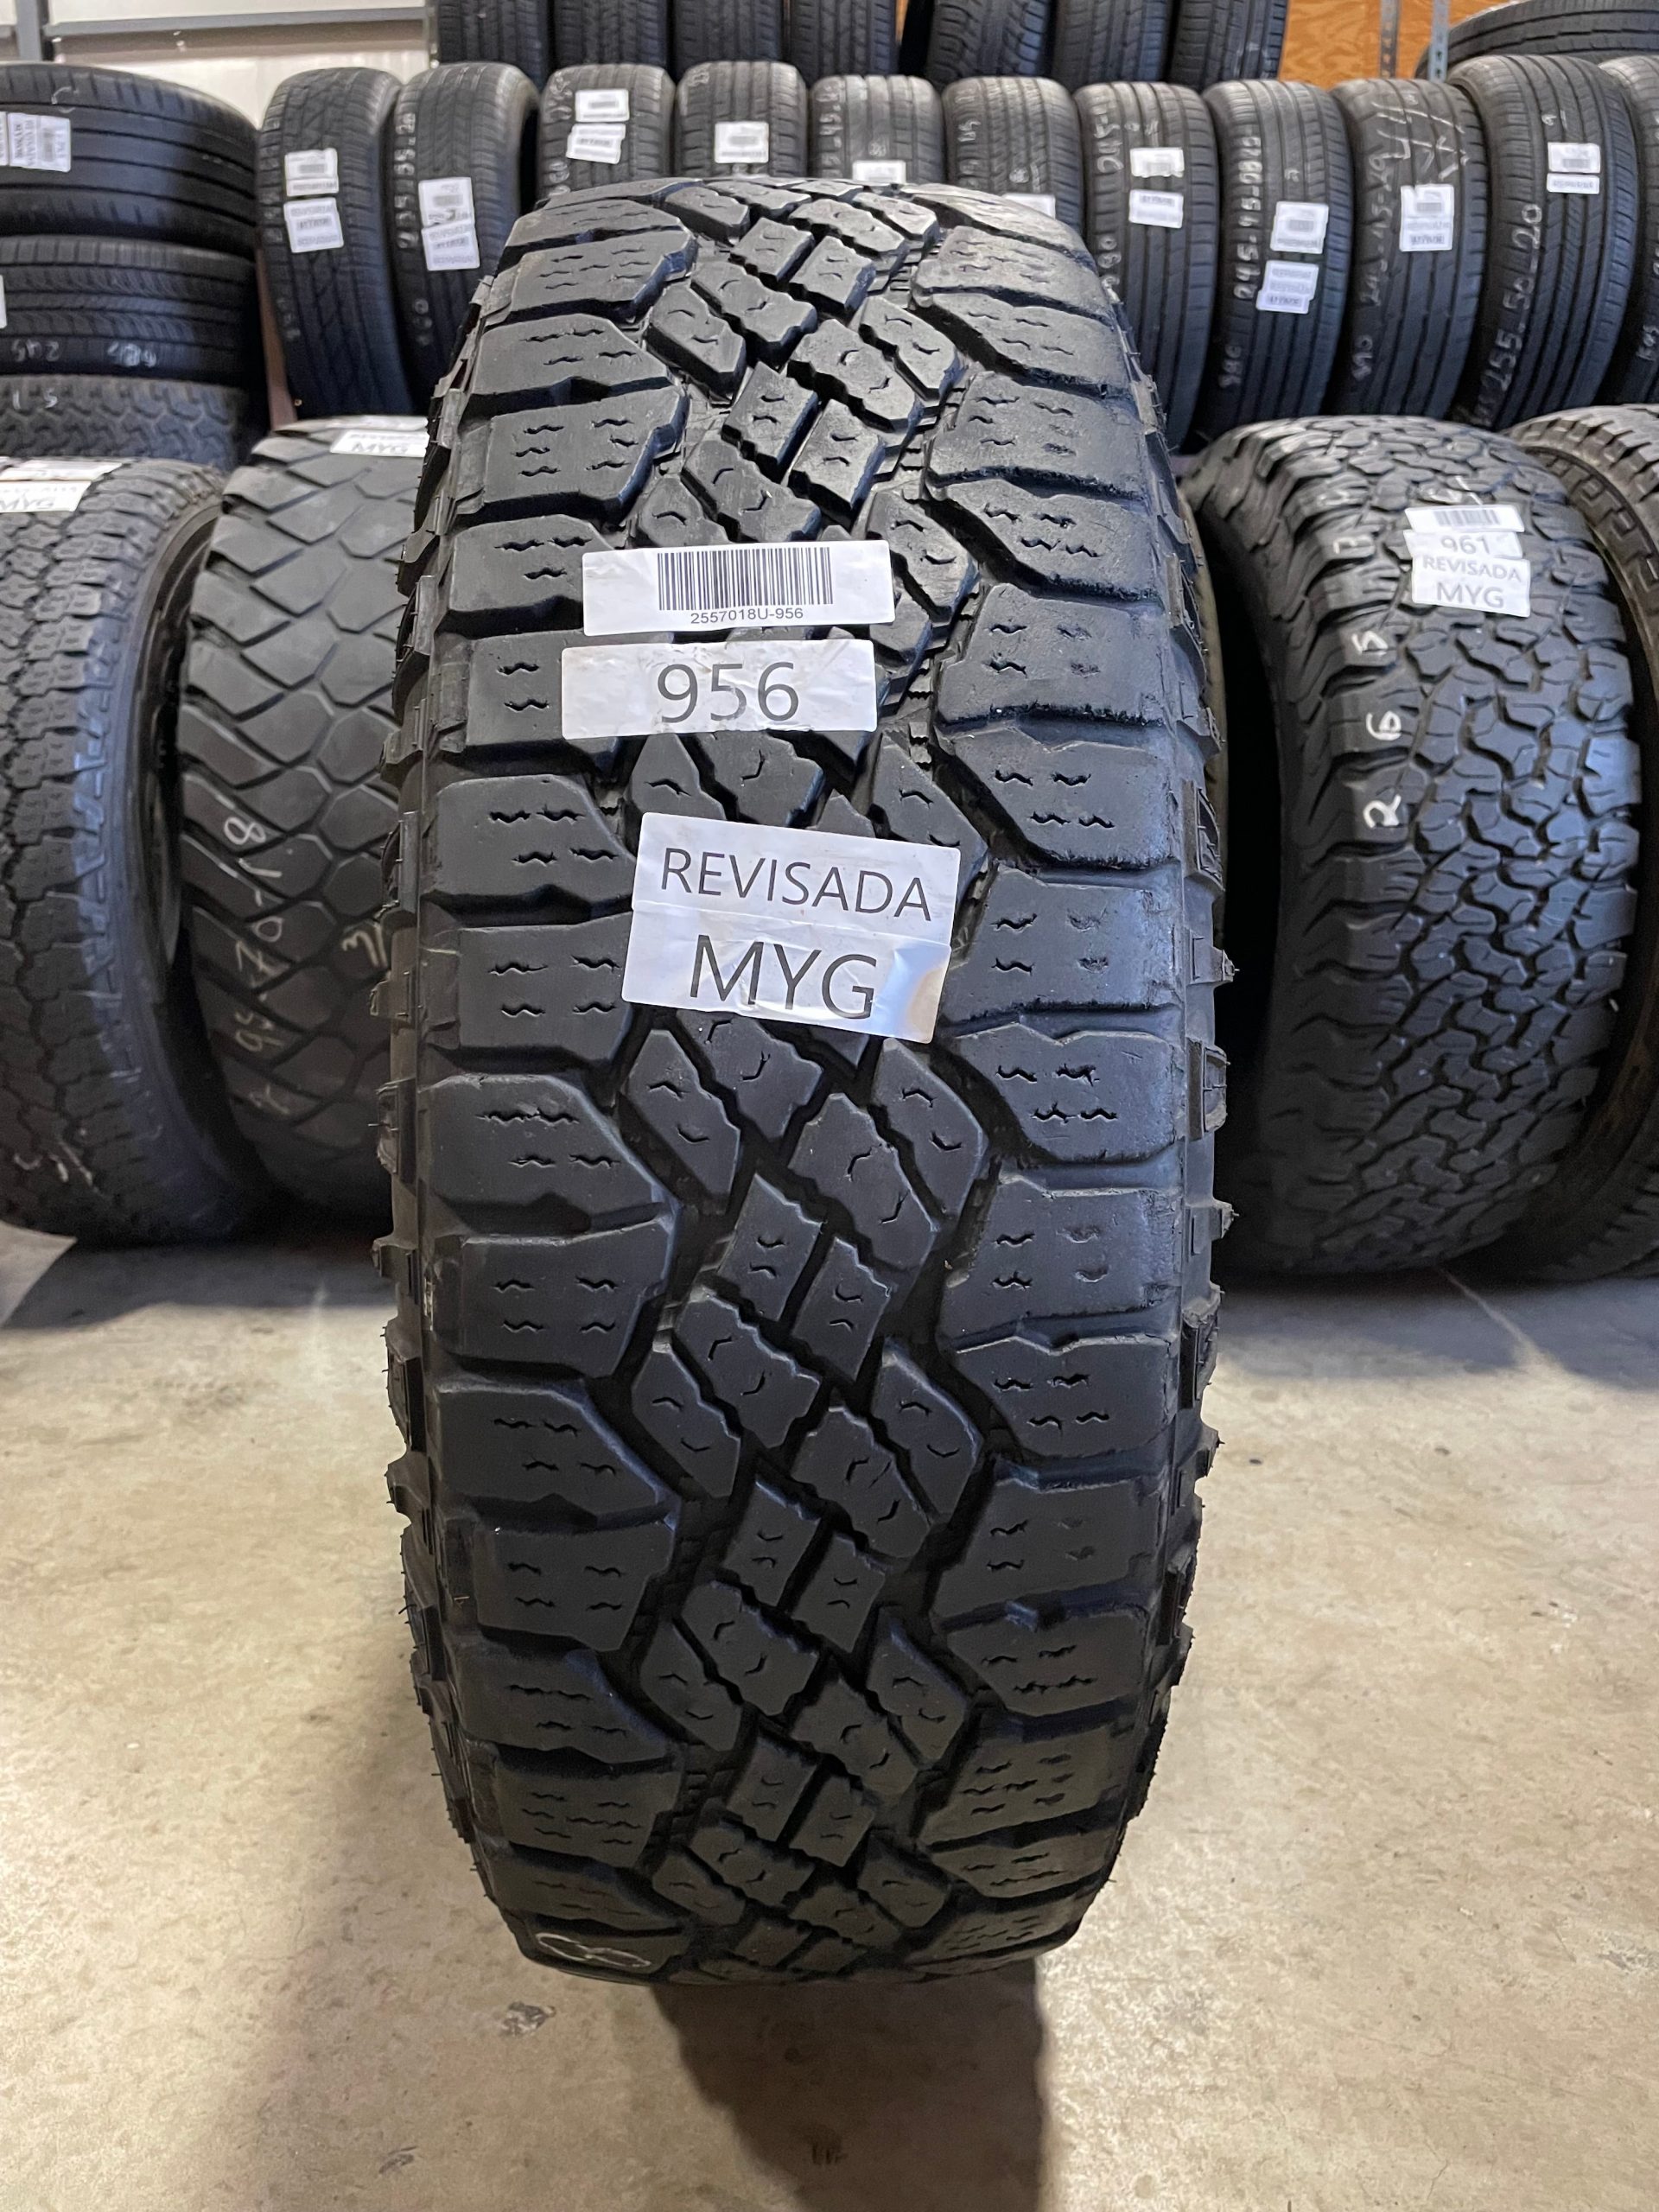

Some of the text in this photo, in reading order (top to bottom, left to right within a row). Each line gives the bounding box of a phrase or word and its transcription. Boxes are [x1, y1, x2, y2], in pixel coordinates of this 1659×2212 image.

[1440, 534, 1491, 556] 961
[1421, 555, 1522, 583] REVISADA
[1436, 582, 1505, 609] MYG
[690, 607, 804, 625] 2557018U-956
[657, 662, 800, 724] 956
[660, 847, 932, 922] REVISADA
[690, 933, 878, 1020] MYG
